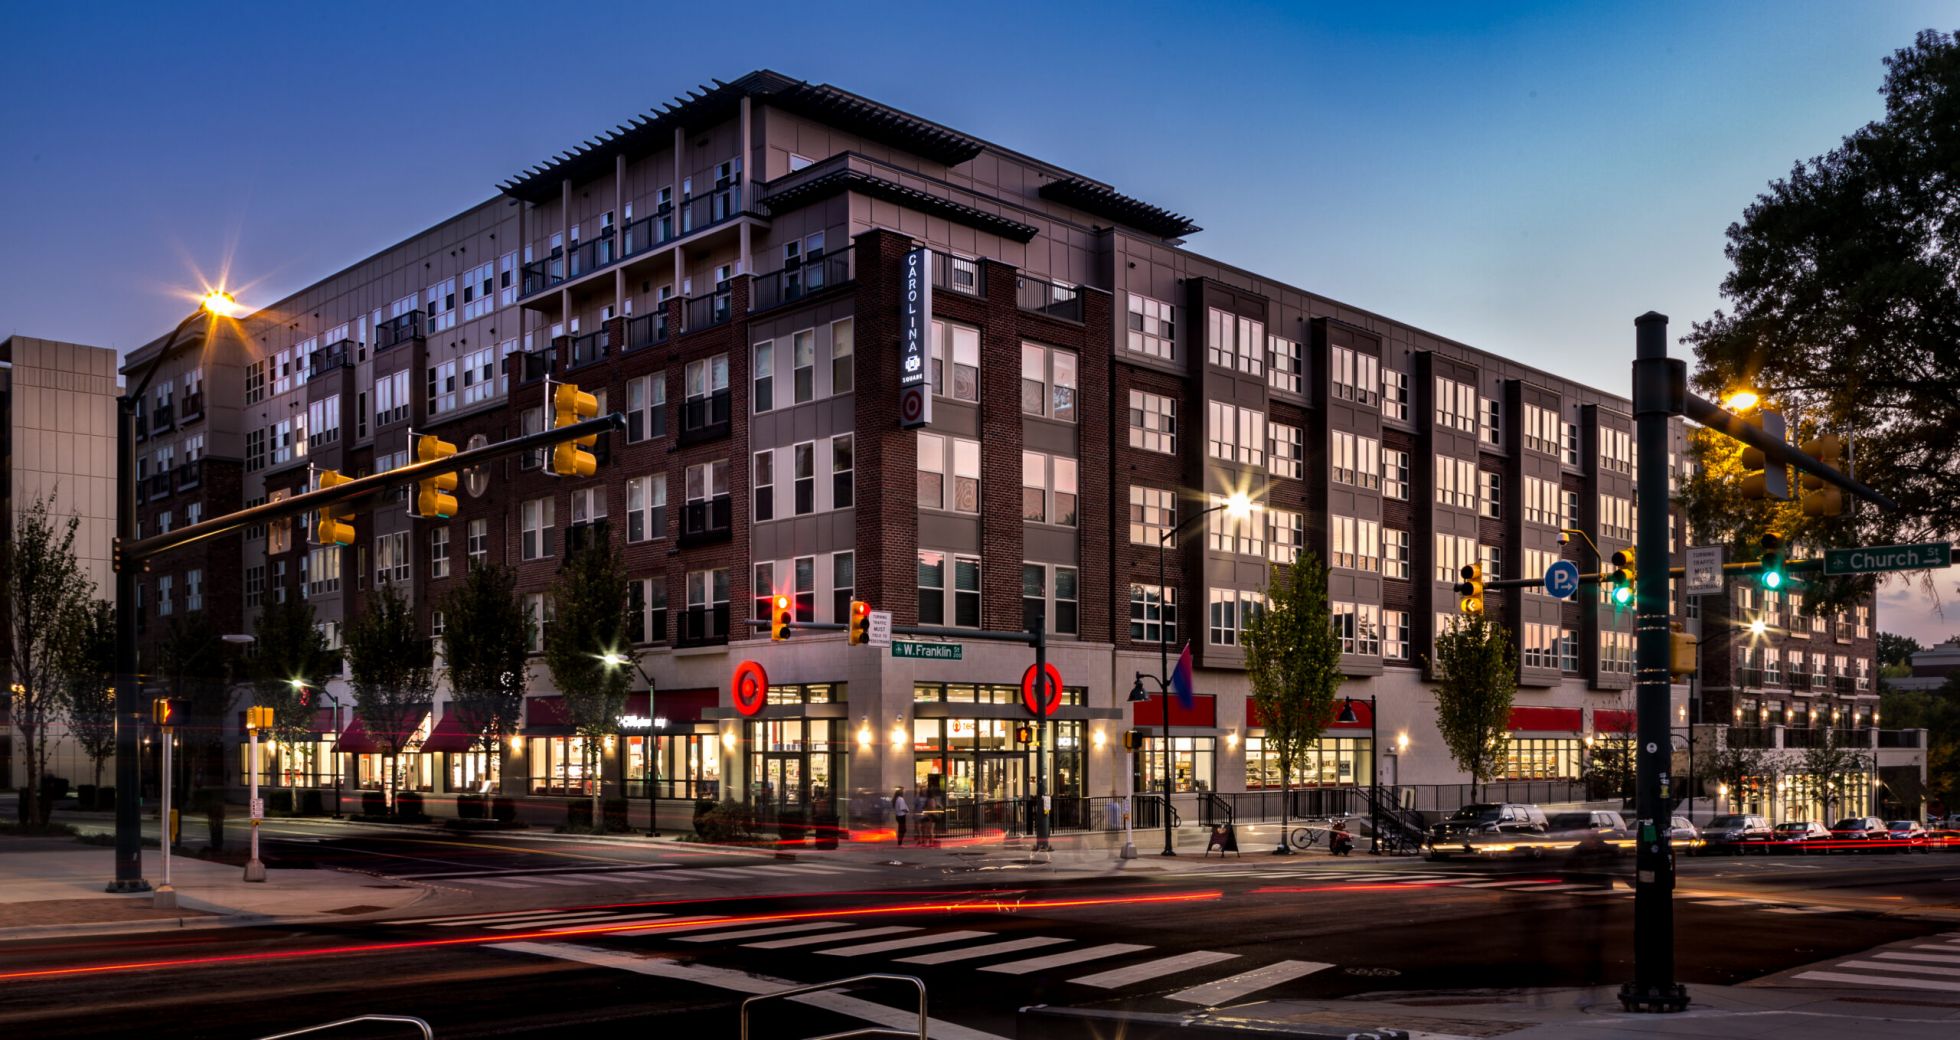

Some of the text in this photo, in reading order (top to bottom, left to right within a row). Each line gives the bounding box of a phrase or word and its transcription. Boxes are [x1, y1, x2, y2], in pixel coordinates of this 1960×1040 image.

[908, 254, 917, 352] CAROLINA
[902, 373, 923, 383] SQUARE
[1850, 547, 1939, 569] Church St
[1554, 569, 1569, 590] P
